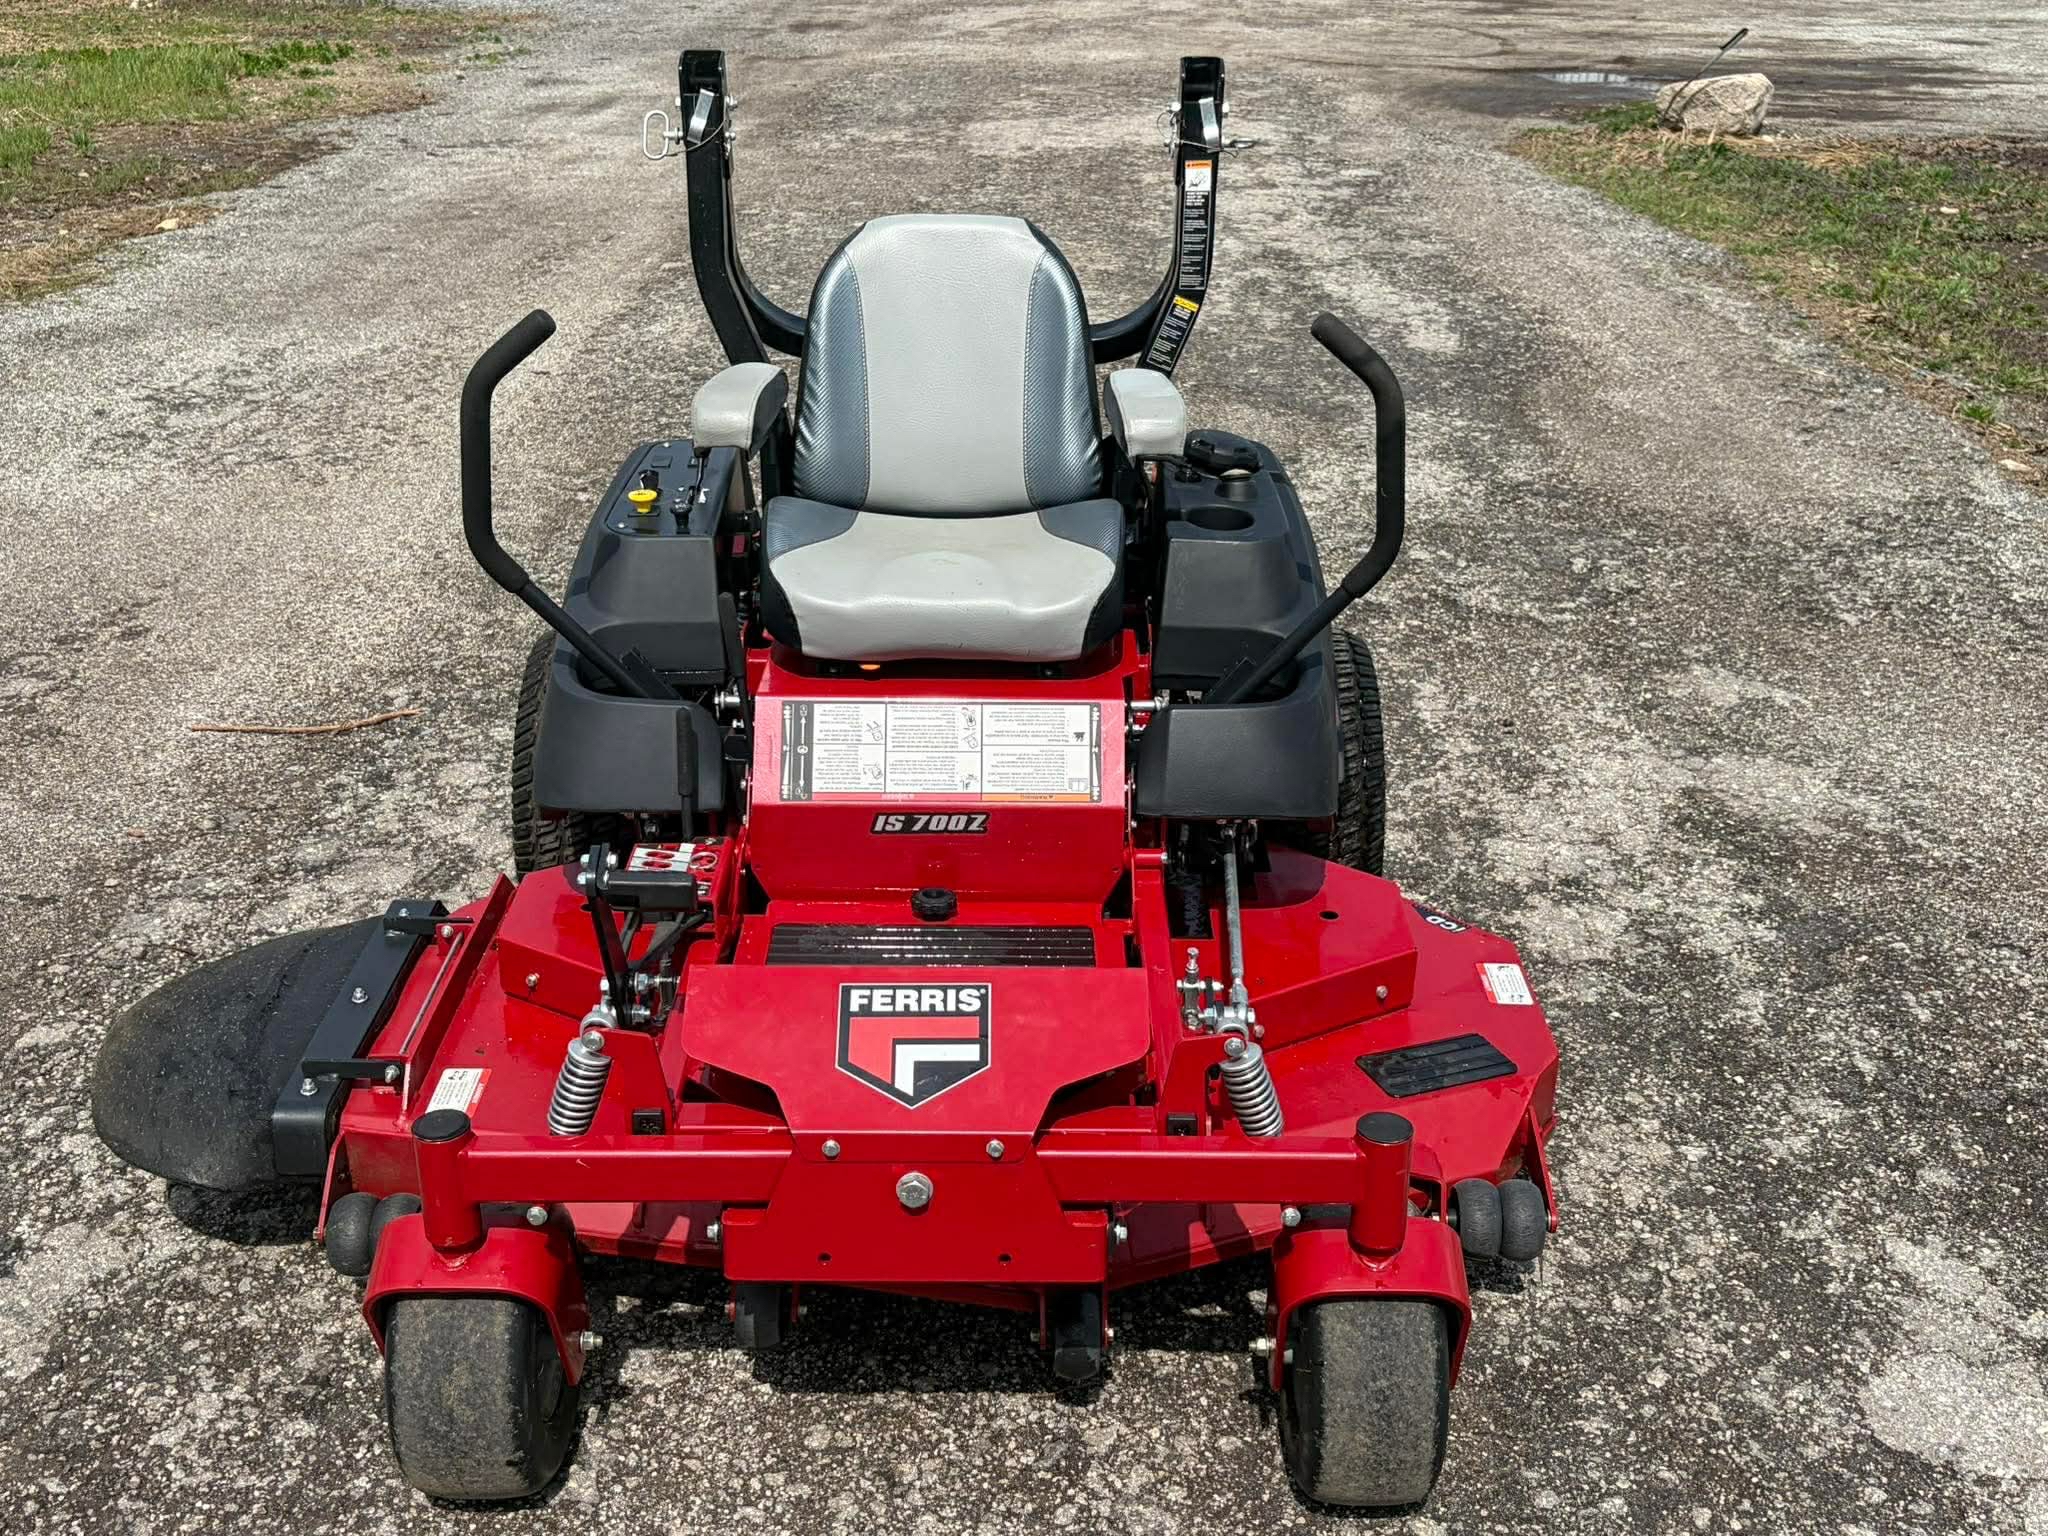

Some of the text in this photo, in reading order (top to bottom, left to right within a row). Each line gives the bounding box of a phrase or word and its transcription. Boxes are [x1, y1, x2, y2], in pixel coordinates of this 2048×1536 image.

[873, 814, 988, 832] IS 700Z
[1426, 915, 1466, 932] ICD
[849, 988, 981, 1013] FERRIS
